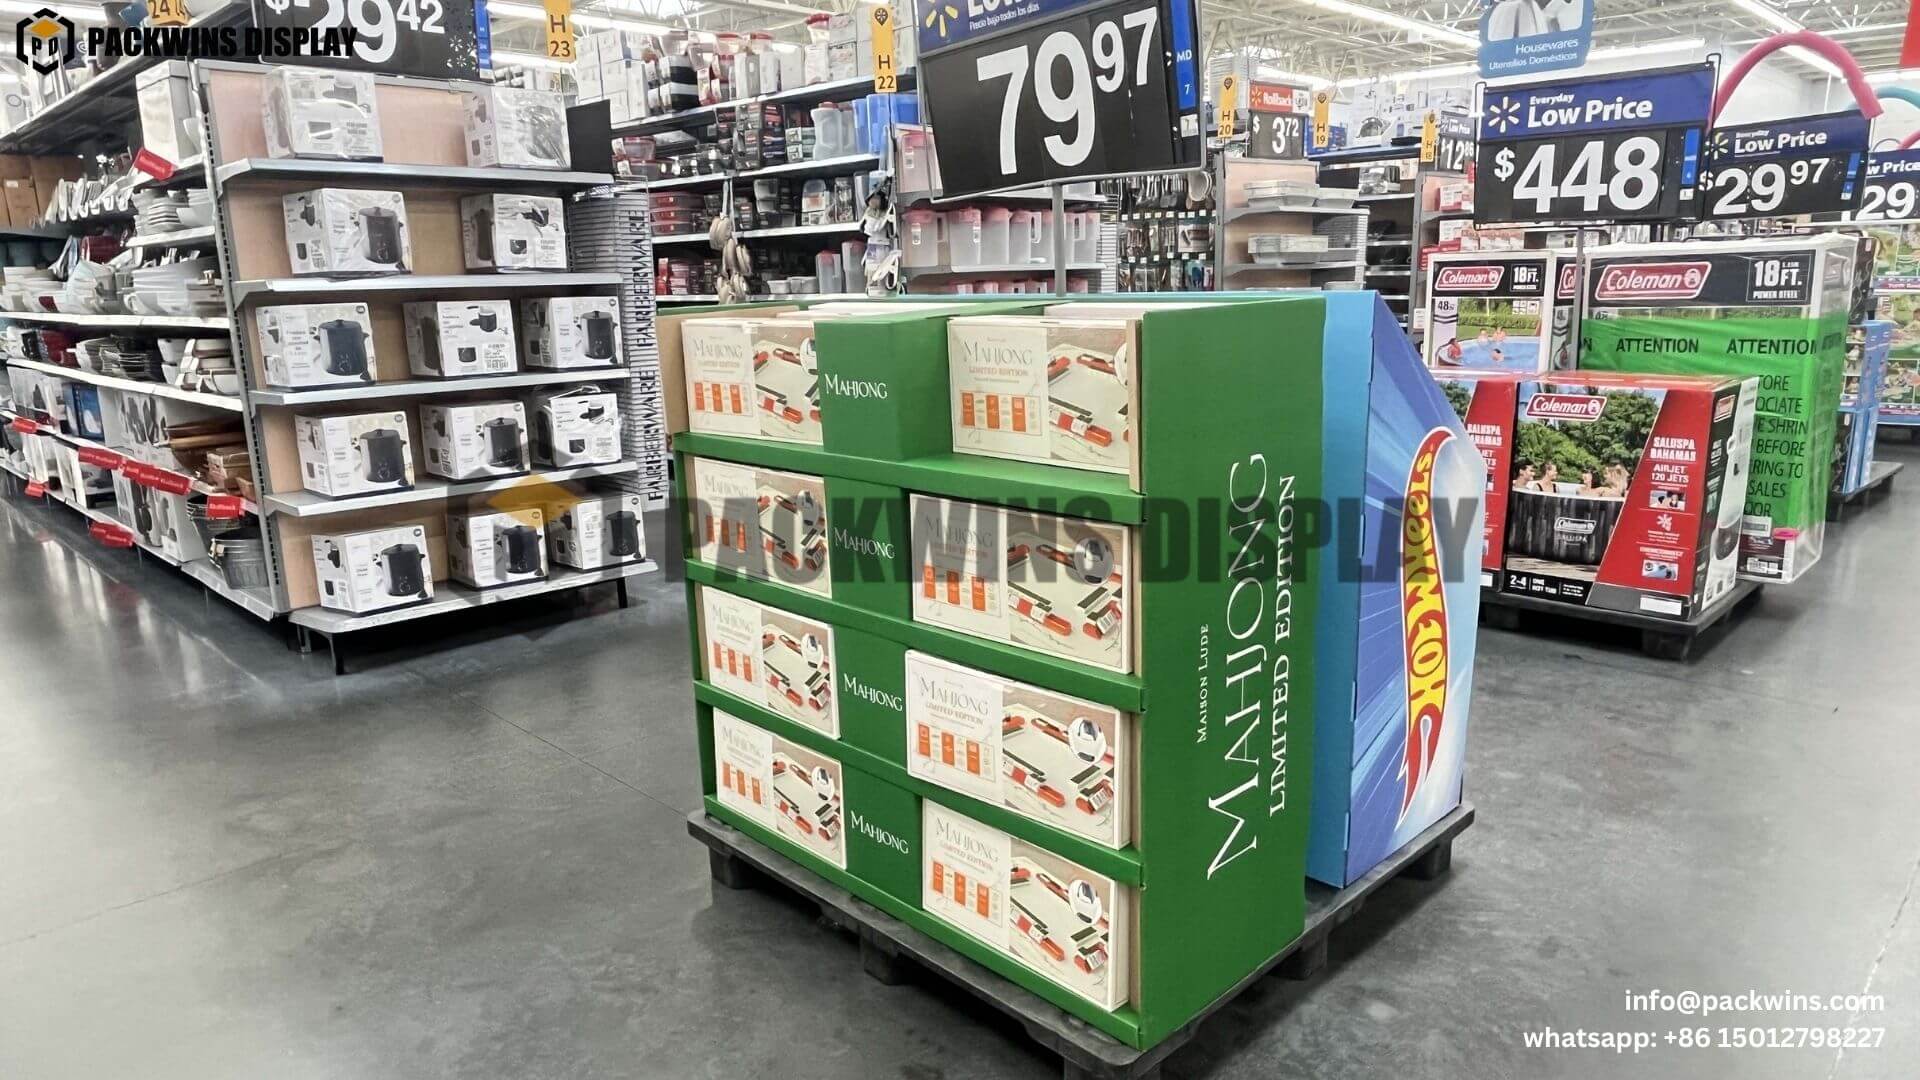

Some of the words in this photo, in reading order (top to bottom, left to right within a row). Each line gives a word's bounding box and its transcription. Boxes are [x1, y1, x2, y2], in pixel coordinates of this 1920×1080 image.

[550, 14, 565, 33] H
[550, 41, 571, 58] 23
[1176, 49, 1193, 62] MD
[1515, 39, 1579, 55] Housewares
[878, 54, 890, 69] H
[877, 76, 895, 89] 22
[976, 31, 1096, 175] 79
[1092, 7, 1158, 93] 97
[1262, 91, 1292, 106] Rollback
[1529, 93, 1575, 105] Everyday
[1528, 106, 1582, 128] Low
[1585, 97, 1654, 123] Price
[1219, 124, 1232, 136] 20
[1272, 117, 1286, 154] 3
[1285, 118, 1299, 137] 72
[1734, 138, 1775, 154] Low
[1777, 131, 1827, 149] Price
[1790, 157, 1830, 185] 97
[1442, 268, 1488, 284] Coleman
[1513, 266, 1527, 283] 18
[1605, 268, 1683, 290] Coleman
[1754, 260, 1780, 287] 18
[1781, 267, 1802, 286] FT.
[1437, 300, 1449, 311] 48
[1616, 338, 1699, 354] ATTENTION
[825, 373, 887, 400] MAHJONG
[1757, 374, 1791, 391] TORE
[1533, 397, 1587, 414] Coleman
[1755, 396, 1803, 414] OCIATE
[1767, 418, 1809, 436] SHRIN
[1653, 436, 1696, 450] SALUSPA
[1756, 439, 1807, 457] BEFORE
[1650, 447, 1696, 461] BAHAMAS
[1653, 463, 1688, 474] AIRJET
[1751, 459, 1784, 477] RING
[1787, 462, 1804, 479] TO
[1651, 472, 1666, 481] 120
[1667, 474, 1689, 483] JETS
[1747, 479, 1788, 498] SALES
[1743, 500, 1772, 517] OOR
[833, 527, 895, 559] MAHJONG
[1274, 474, 1296, 645] EDITION
[1510, 575, 1527, 587] 2-4
[1206, 452, 1268, 881] MAHJONG
[844, 673, 904, 711] MAHJONG
[1269, 654, 1290, 818] LIMITED
[850, 810, 909, 855] MAHJONG
